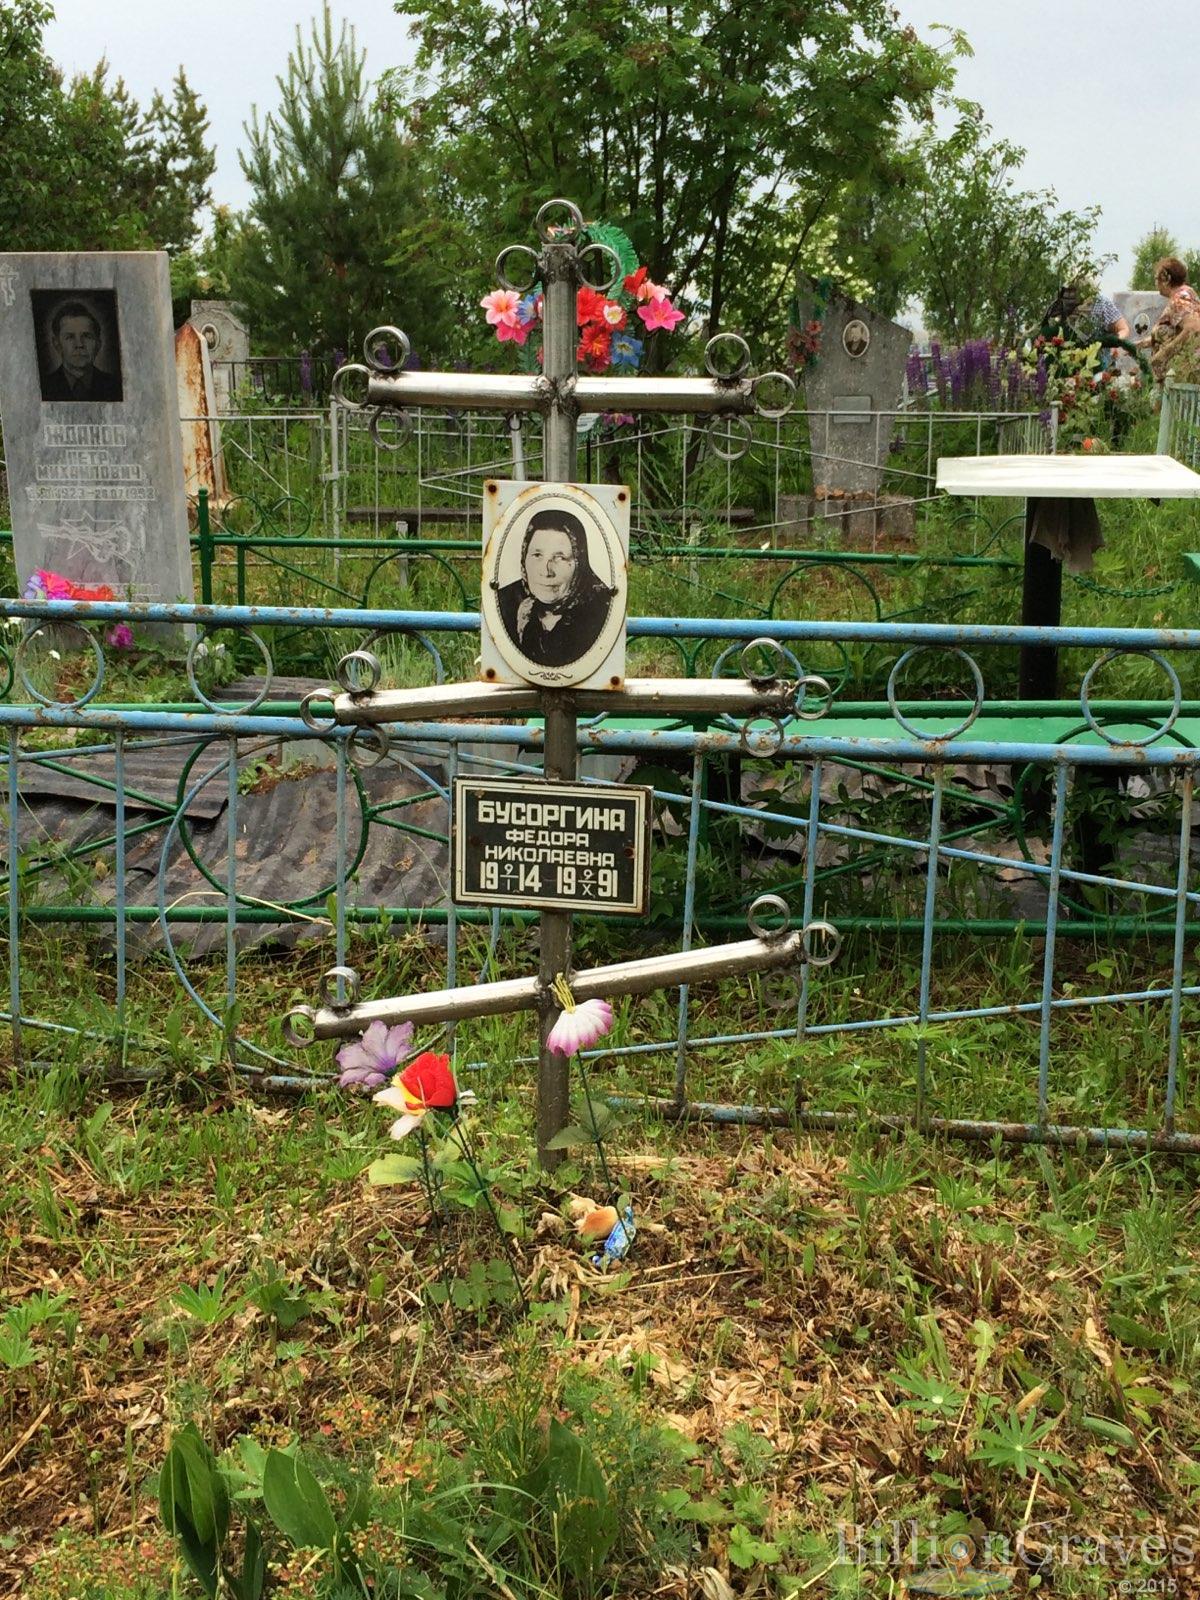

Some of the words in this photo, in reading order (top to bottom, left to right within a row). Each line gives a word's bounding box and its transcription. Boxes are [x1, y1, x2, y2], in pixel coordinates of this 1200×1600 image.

[478, 800, 626, 832] БУСОРГИНА
[505, 828, 590, 848] ФЕДОРА
[484, 845, 615, 868] НИКОЛАЕВНА
